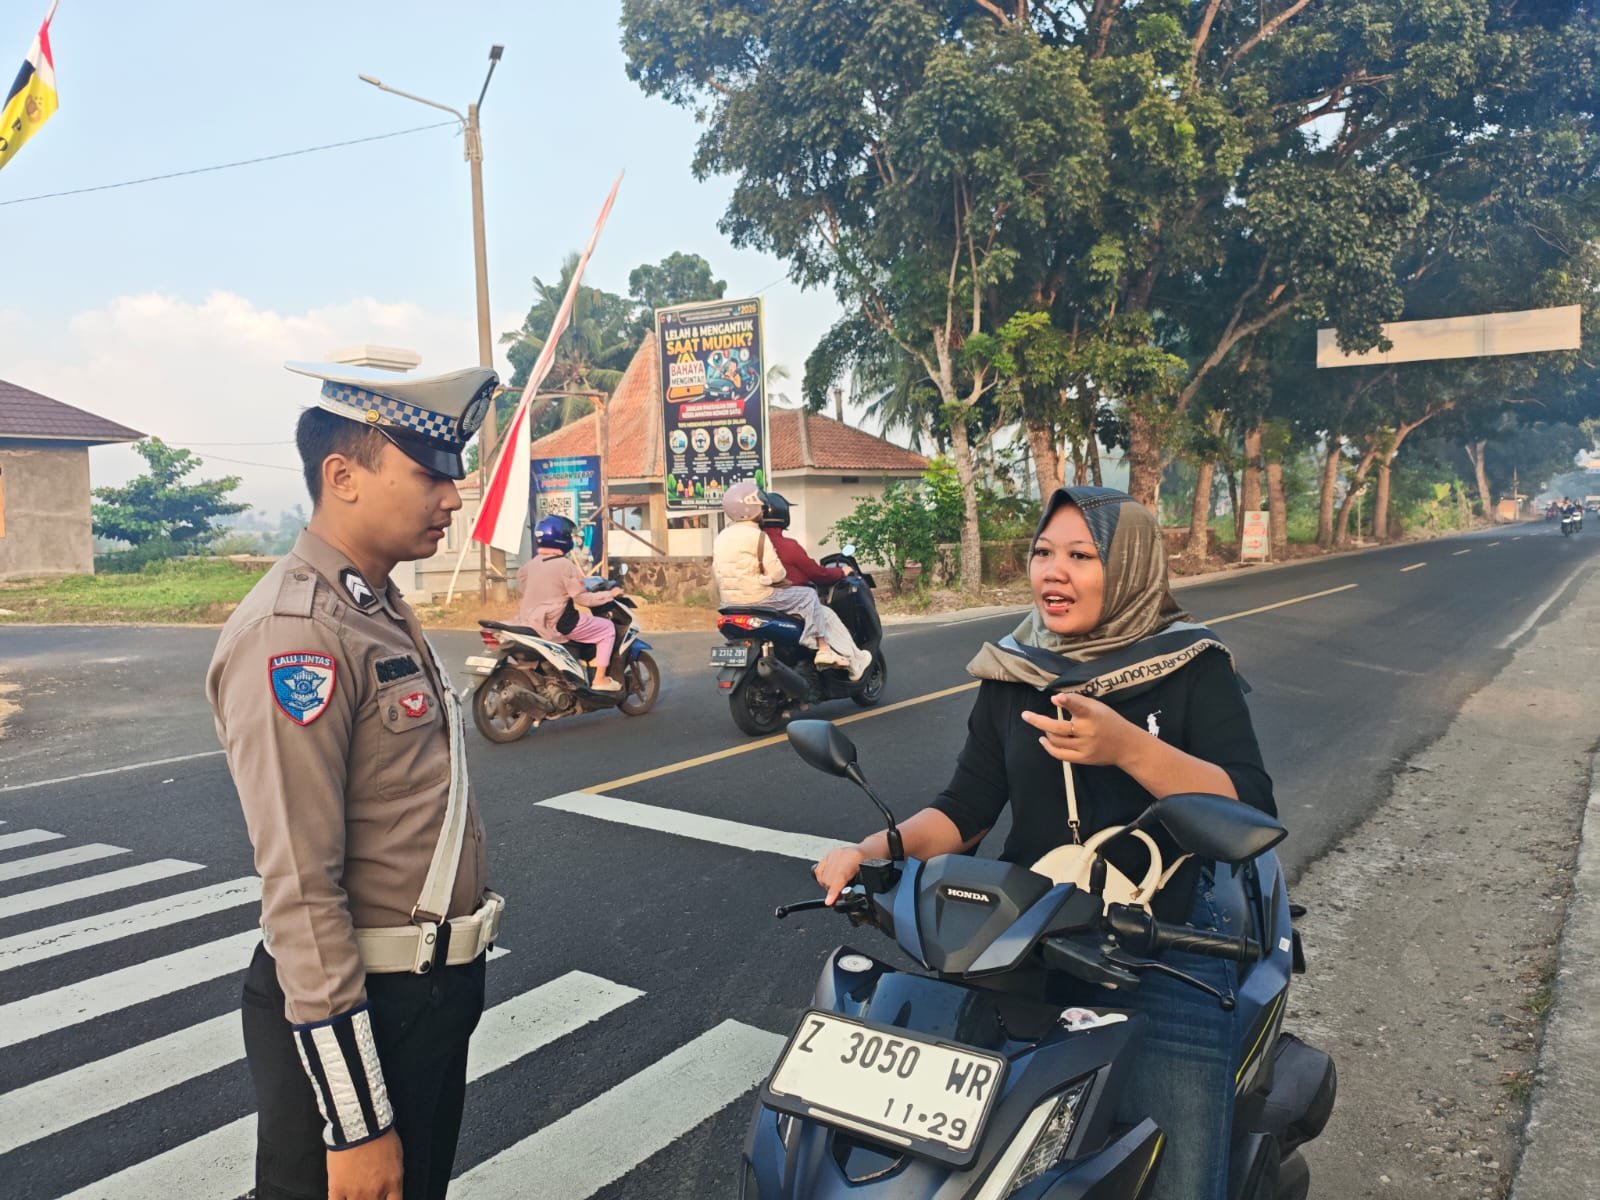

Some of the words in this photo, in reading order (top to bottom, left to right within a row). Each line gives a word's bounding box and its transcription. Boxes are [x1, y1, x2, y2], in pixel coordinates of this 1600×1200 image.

[665, 327, 691, 341] LELAH
[692, 326, 699, 338] &
[700, 319, 754, 337] MENGANTUK
[666, 337, 700, 355] SAAT
[702, 332, 753, 351] MUDIK?
[671, 362, 704, 377] BAHAYA
[273, 655, 298, 666] LALU
[300, 655, 331, 667] LINTAS
[947, 888, 990, 903] HONDA
[797, 1020, 825, 1053] Z
[840, 1032, 921, 1079] 3050
[945, 1058, 992, 1101] WR
